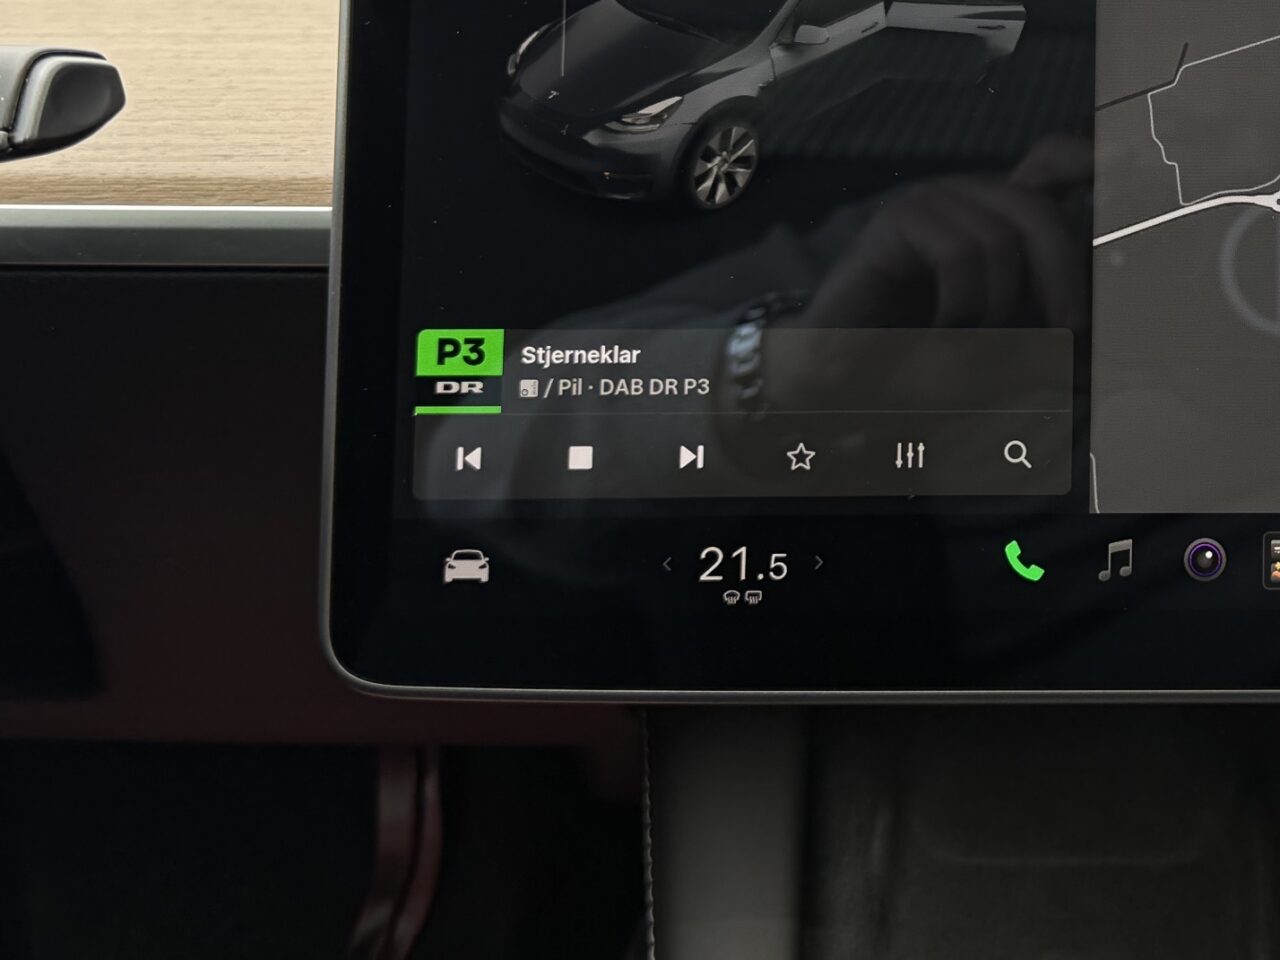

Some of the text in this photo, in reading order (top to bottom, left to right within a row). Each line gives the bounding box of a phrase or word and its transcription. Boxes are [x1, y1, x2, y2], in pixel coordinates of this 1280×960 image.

[436, 338, 487, 366] P3
[521, 345, 642, 368] Stjerneklar
[435, 381, 484, 394] DR
[558, 378, 583, 395] Pil
[600, 378, 644, 395] DAB
[649, 378, 678, 395] DR
[684, 378, 710, 395] P3
[699, 546, 788, 581] 21.5
